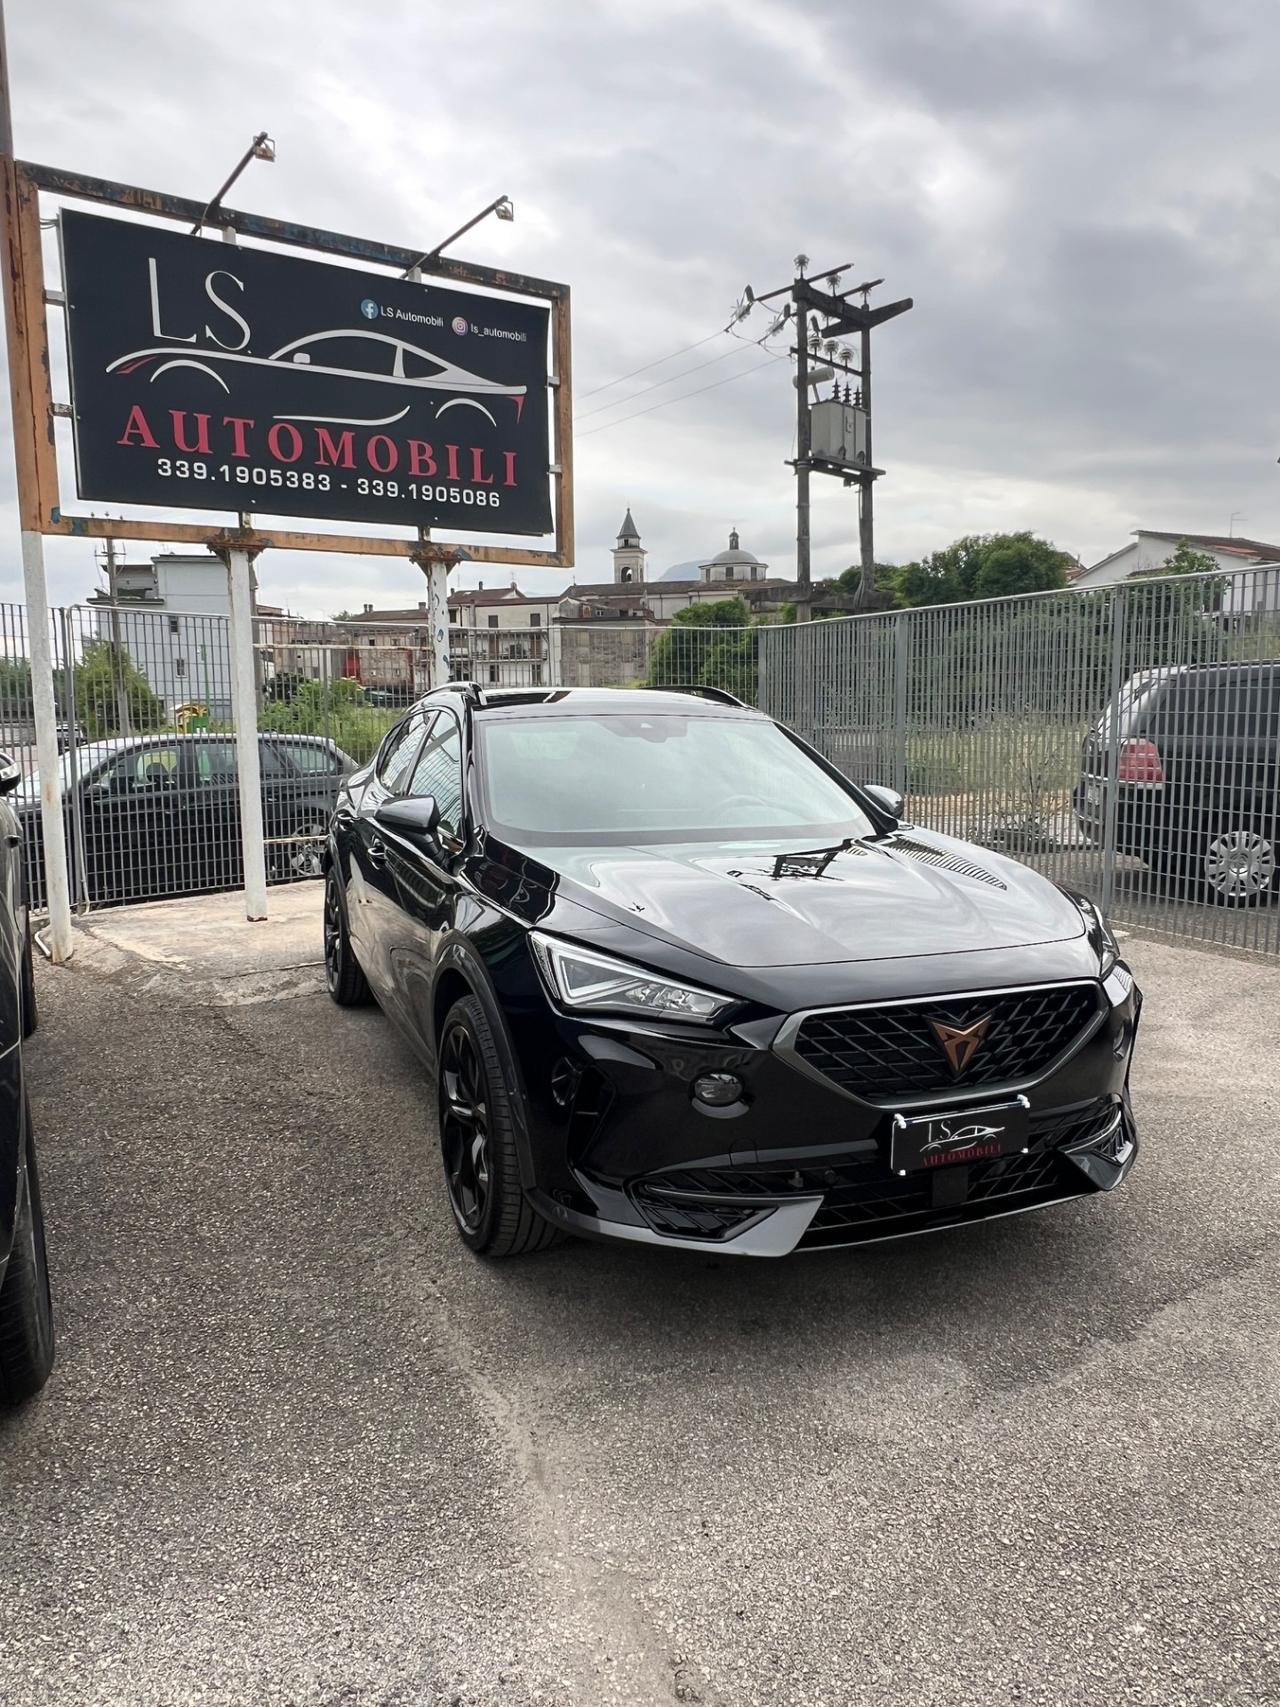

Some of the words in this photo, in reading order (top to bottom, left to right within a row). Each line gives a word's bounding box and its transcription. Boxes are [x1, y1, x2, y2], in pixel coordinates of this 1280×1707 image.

[148, 256, 251, 352] LS
[380, 305, 394, 318] LS
[395, 309, 444, 328] Automobili
[116, 404, 518, 487] AUTOMOBILI
[157, 458, 331, 492] 339.1905383
[357, 478, 500, 508] 339.1905086
